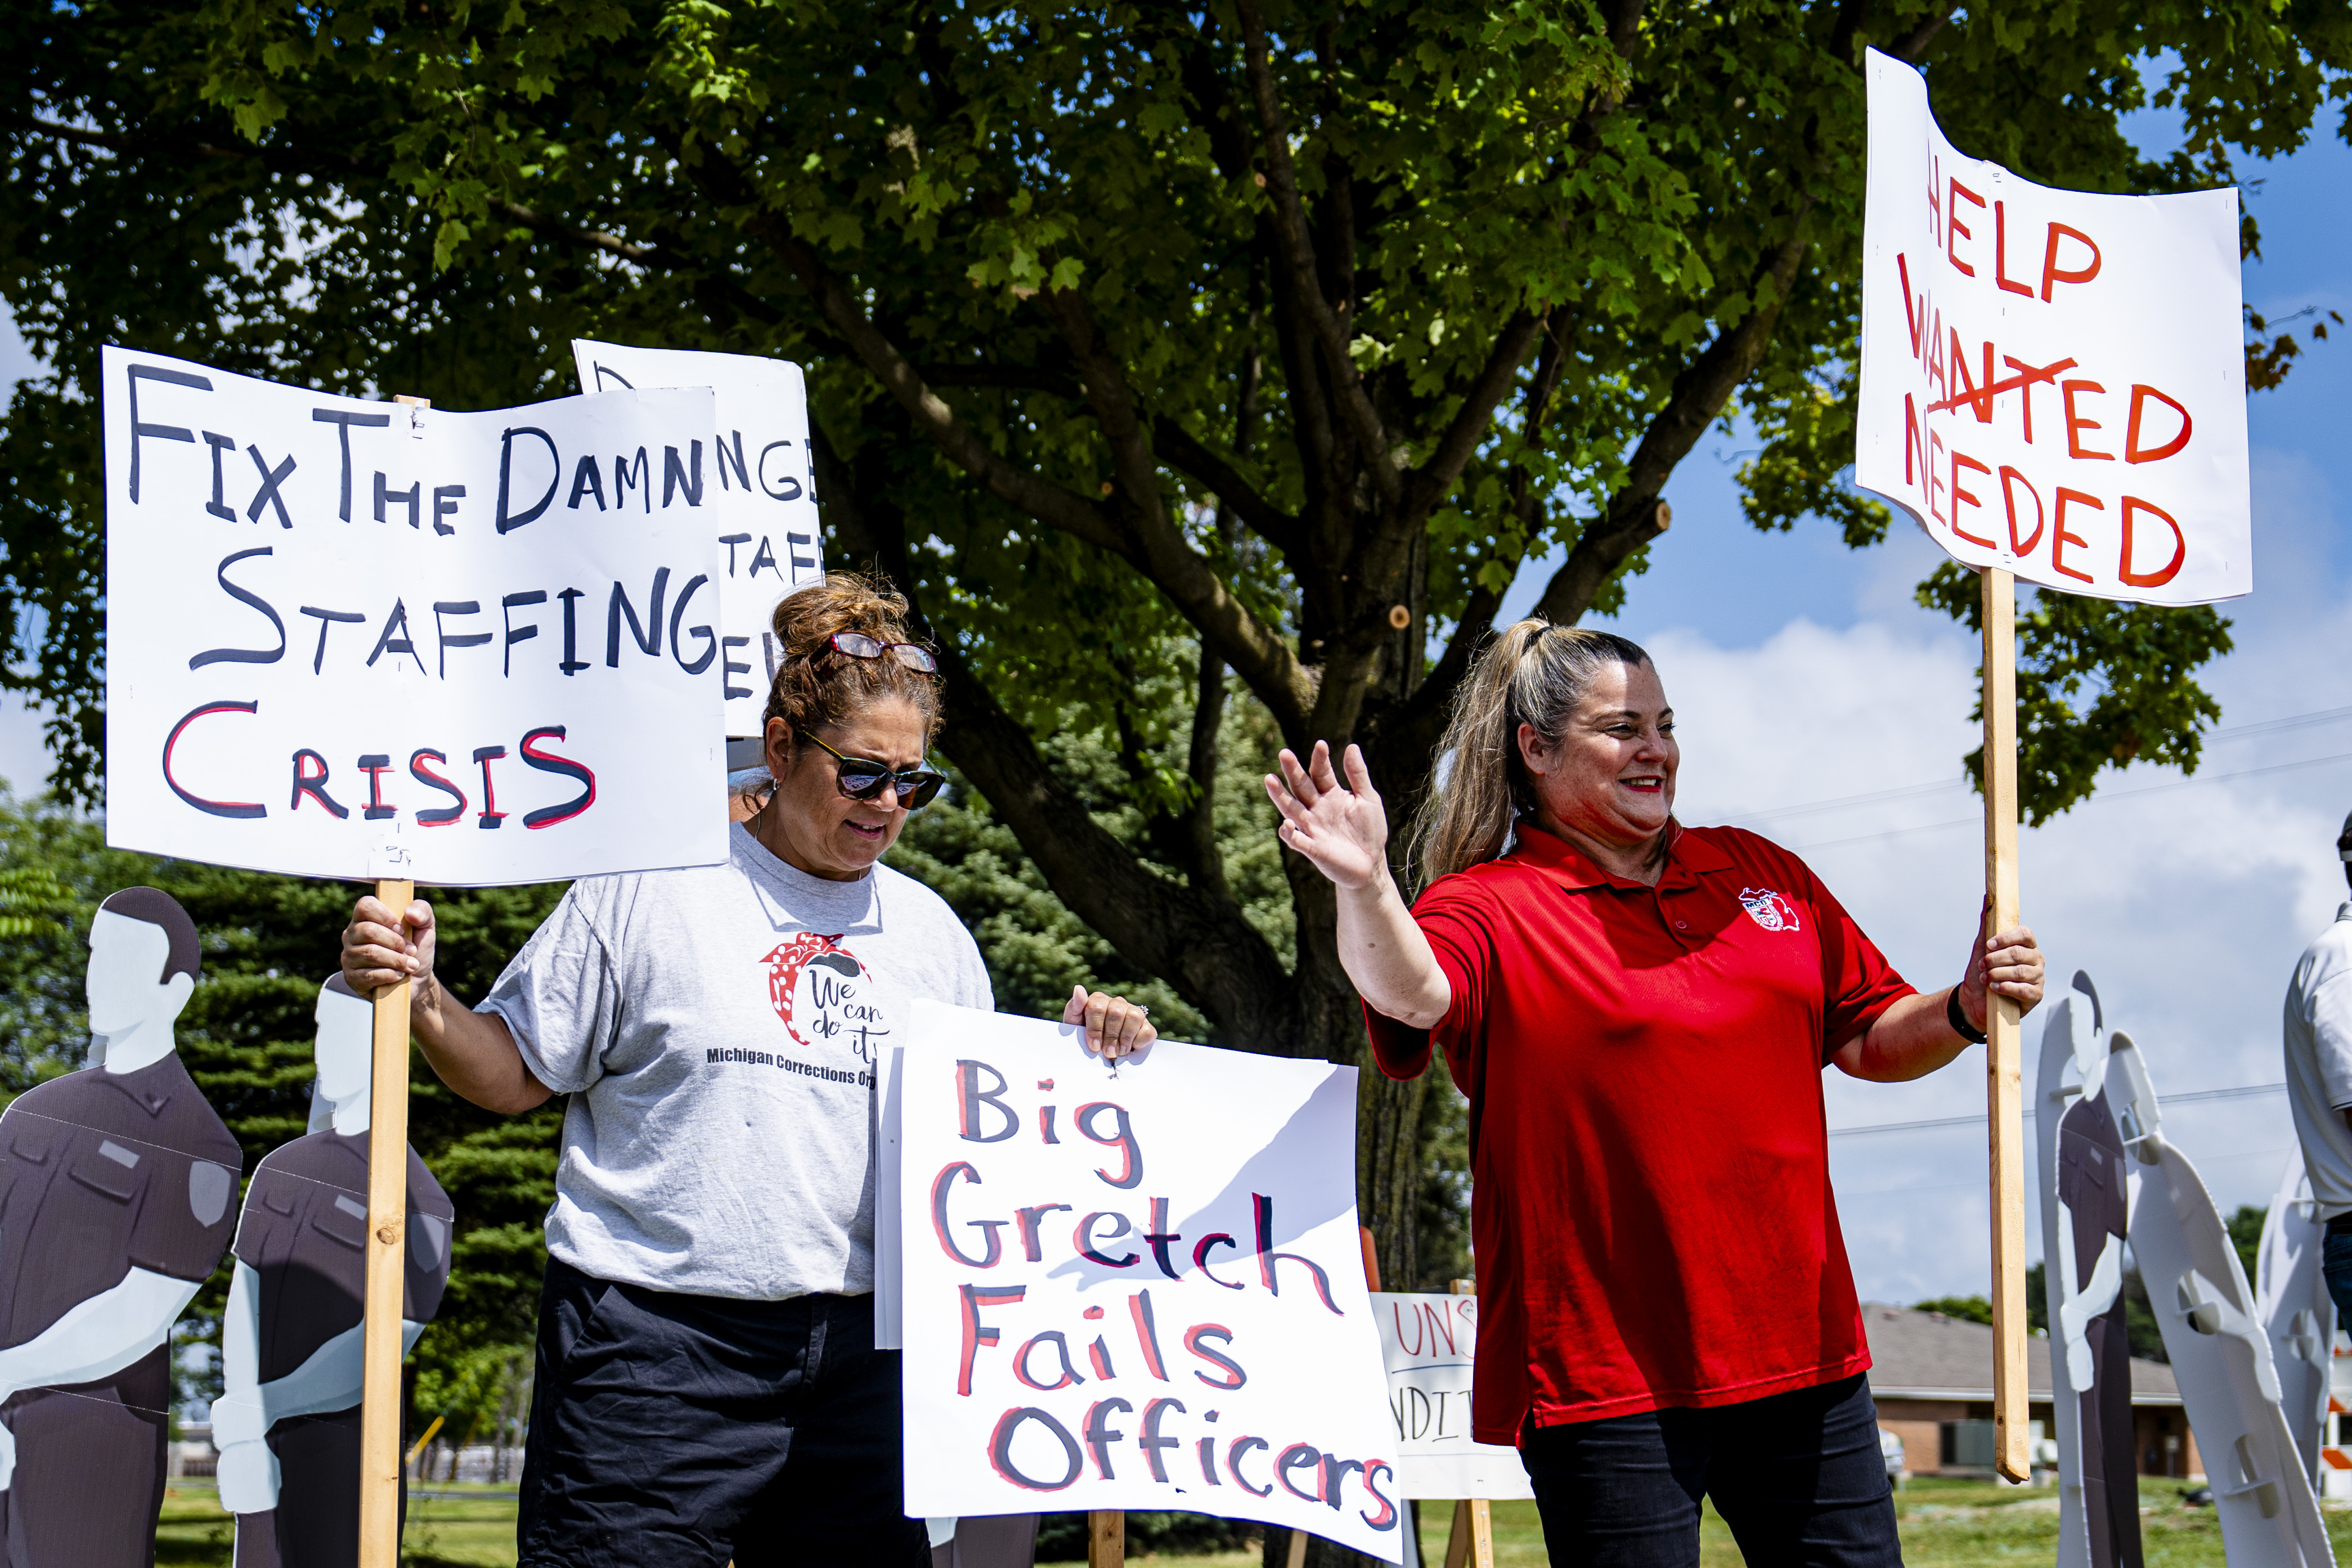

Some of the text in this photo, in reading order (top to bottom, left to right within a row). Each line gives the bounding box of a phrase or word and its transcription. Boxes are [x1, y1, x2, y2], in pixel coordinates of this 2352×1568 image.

[1928, 138, 2101, 304] HELP
[1897, 253, 2192, 465] WANTED
[127, 363, 703, 537] FIX THE DAMN
[1905, 392, 2185, 588] NEEDED
[189, 546, 717, 681] STAFFING
[162, 699, 596, 830] CRISIS
[809, 969, 856, 1009] We
[813, 1010, 843, 1039] do
[843, 1004, 883, 1022] can
[706, 1048, 773, 1065] Michigan
[776, 1054, 855, 1084] Corrections
[955, 1059, 1143, 1189] Big
[930, 1160, 1345, 1317] Gretch
[956, 1288, 1248, 1398] Fails
[986, 1396, 1399, 1533] Officers
